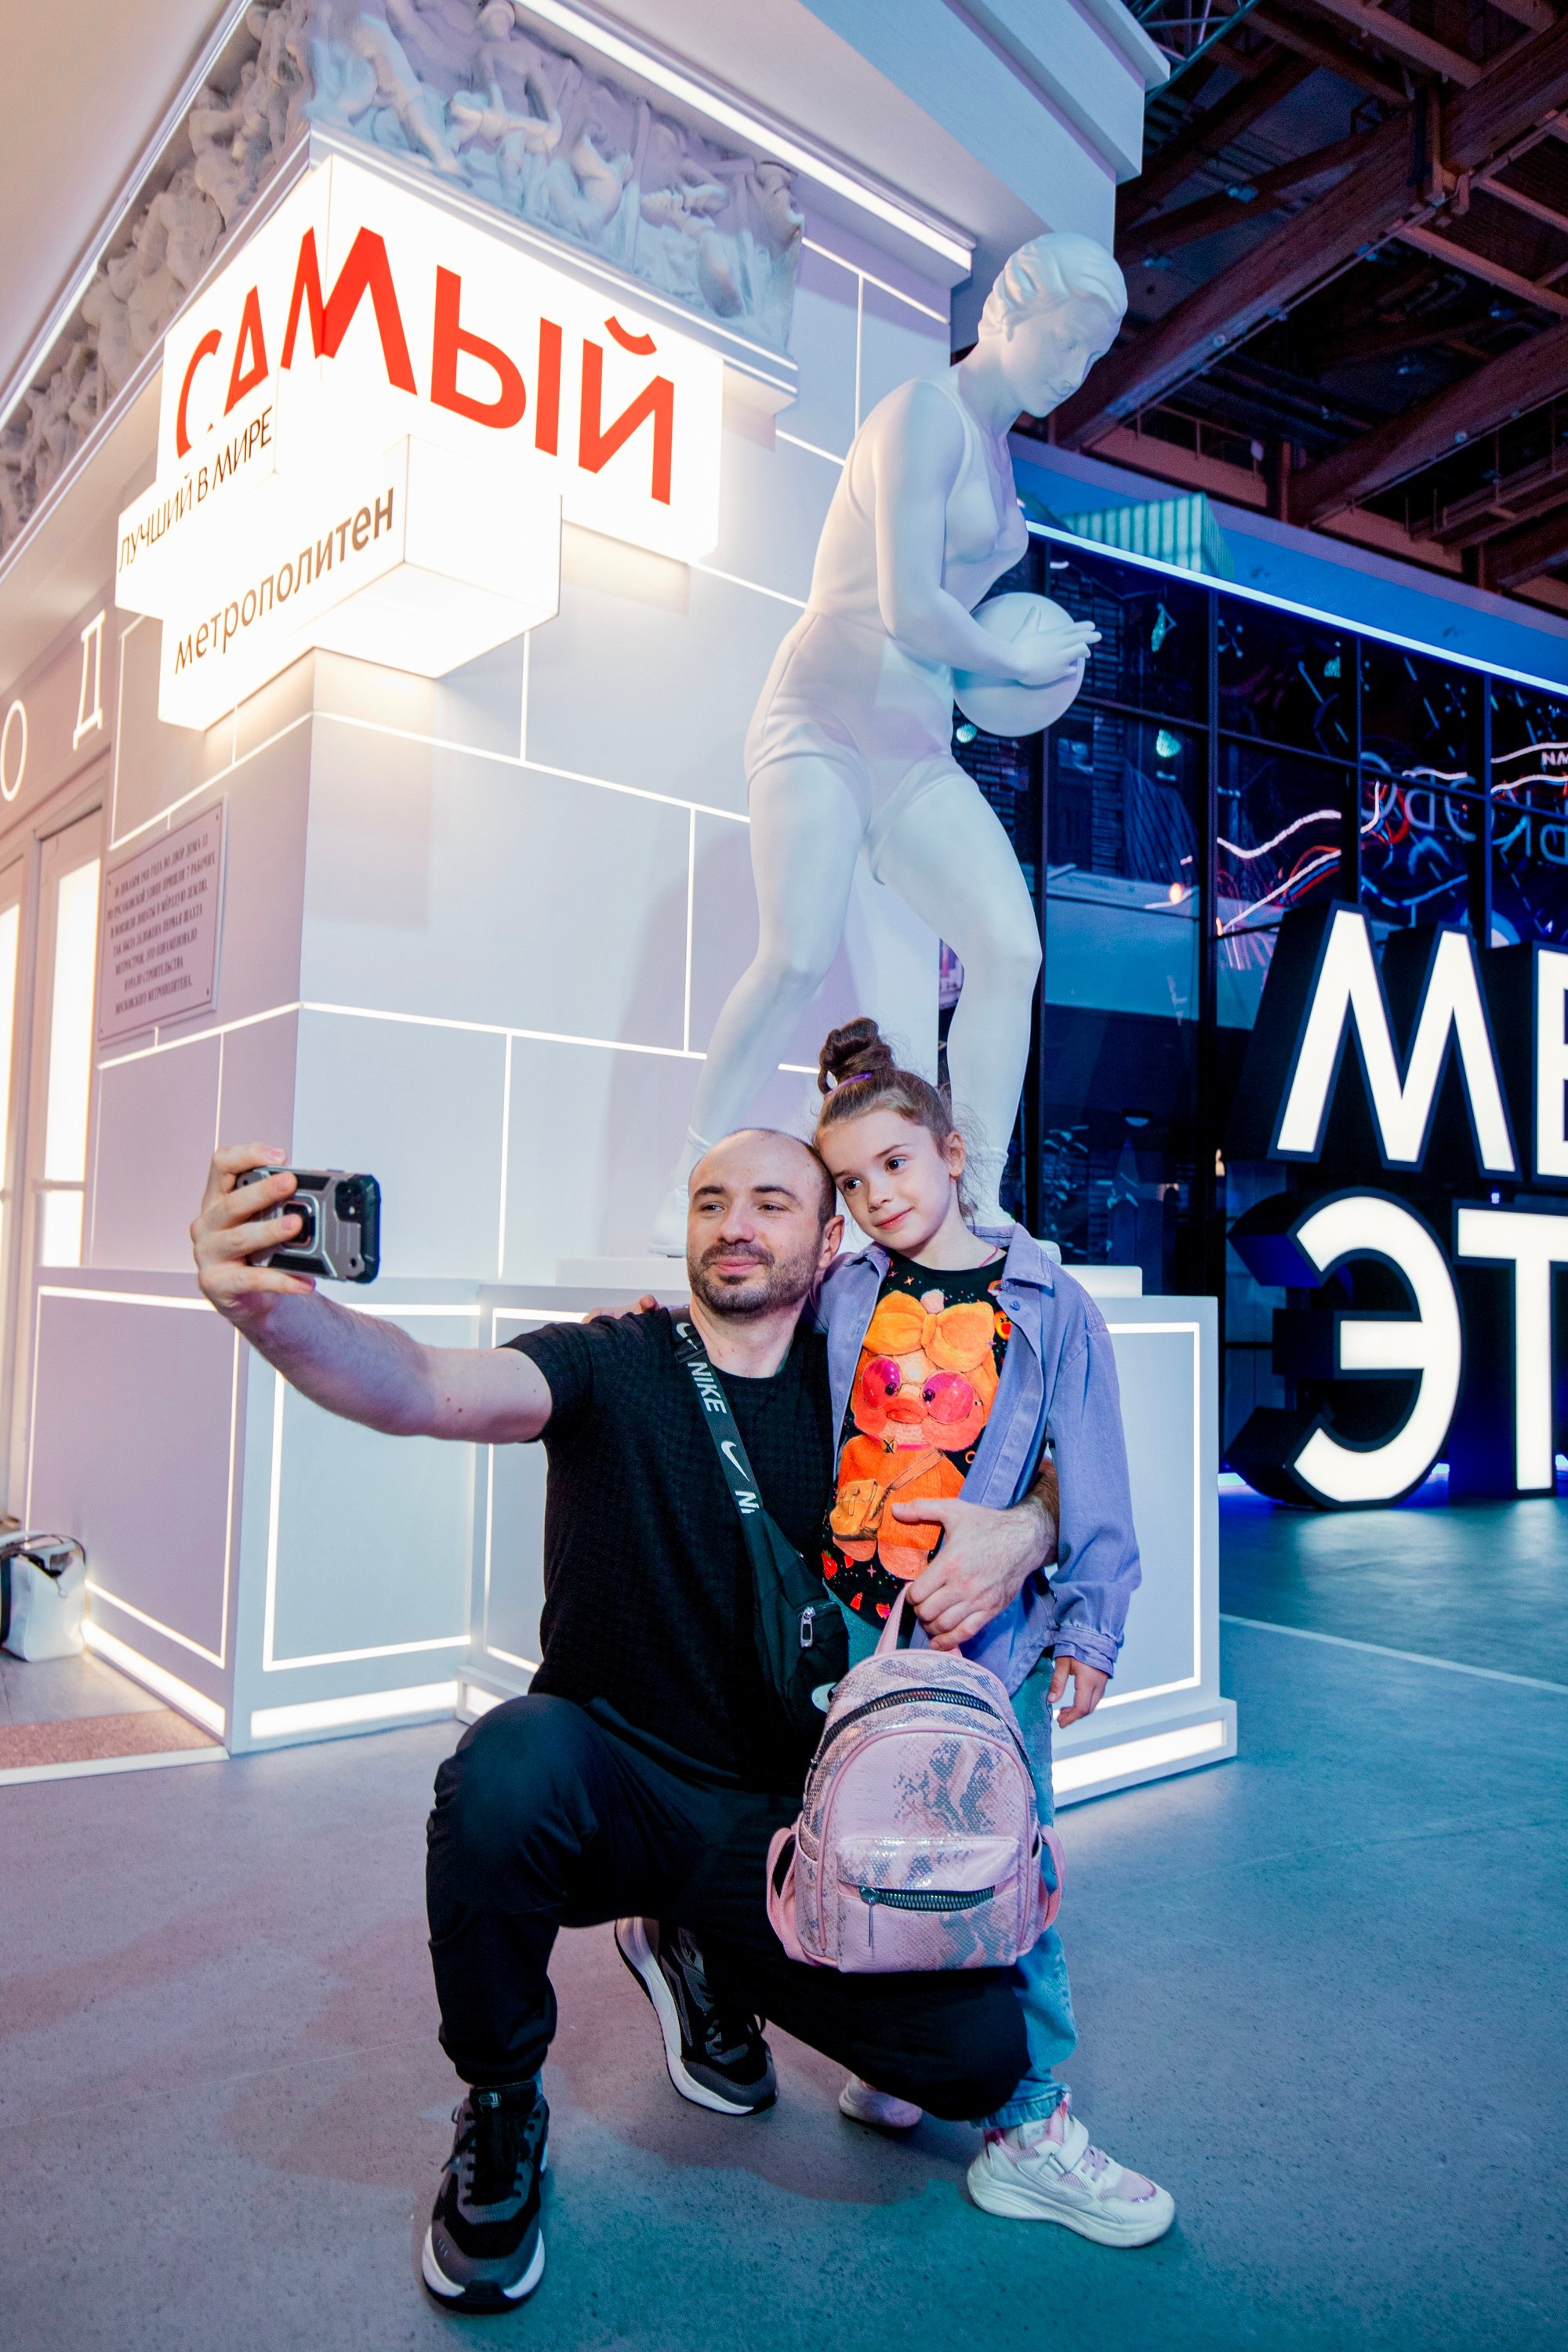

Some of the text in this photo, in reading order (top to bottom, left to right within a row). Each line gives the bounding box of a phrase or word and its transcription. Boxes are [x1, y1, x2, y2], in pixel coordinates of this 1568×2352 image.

[176, 226, 674, 506] САМЫЙ
[118, 405, 273, 572] ЛУЧШИЙ В МИРЕ
[175, 487, 394, 674] метрополитен
[687, 1362, 728, 1414] NIKE
